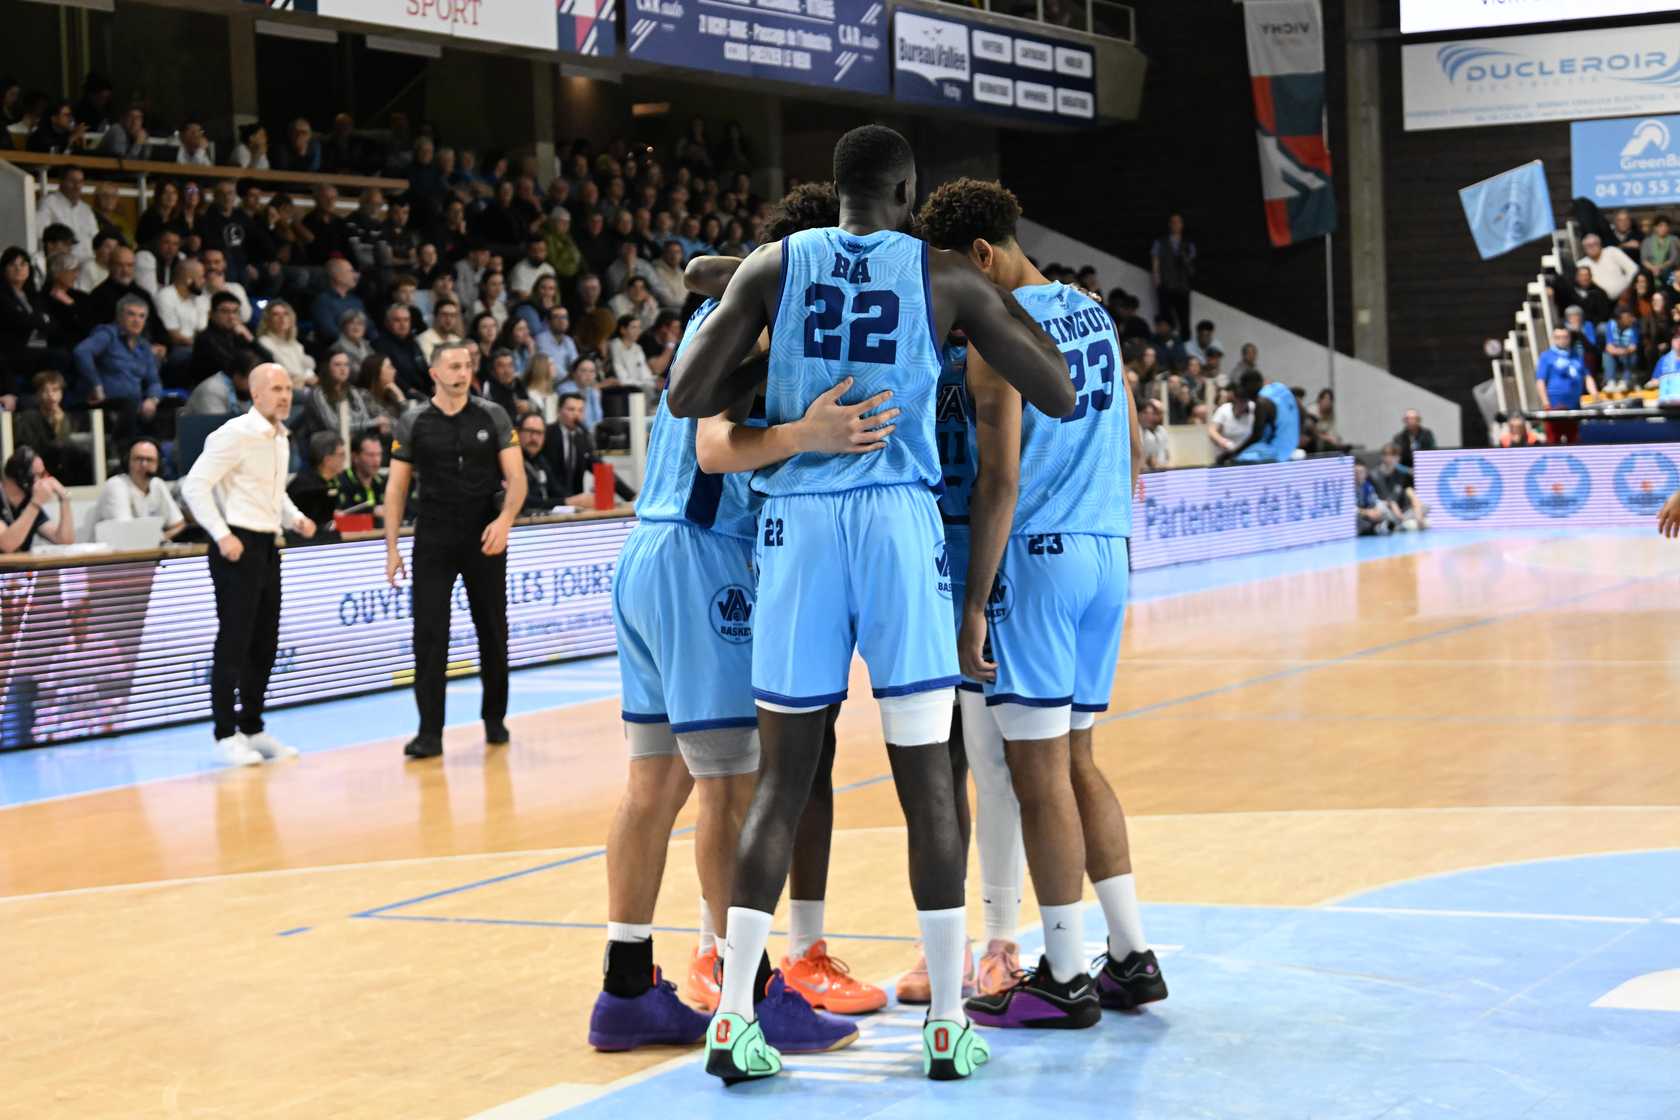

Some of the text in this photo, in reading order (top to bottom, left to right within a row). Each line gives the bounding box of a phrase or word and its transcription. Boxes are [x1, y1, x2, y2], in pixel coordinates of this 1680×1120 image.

[406, 0, 482, 25] SPORT
[1466, 52, 1667, 81] DUCLEROIR
[1595, 182, 1617, 198] 04
[1622, 181, 1644, 196] 70
[1648, 180, 1669, 195] 55
[803, 282, 900, 365] 22
[1061, 339, 1115, 424] 23
[1145, 490, 1250, 540] Partenaire
[1258, 487, 1282, 526] de
[1286, 484, 1303, 522] la
[764, 518, 784, 546] 22
[1028, 533, 1064, 555] 23
[339, 586, 414, 626] OUVE
[511, 571, 543, 604] LES
